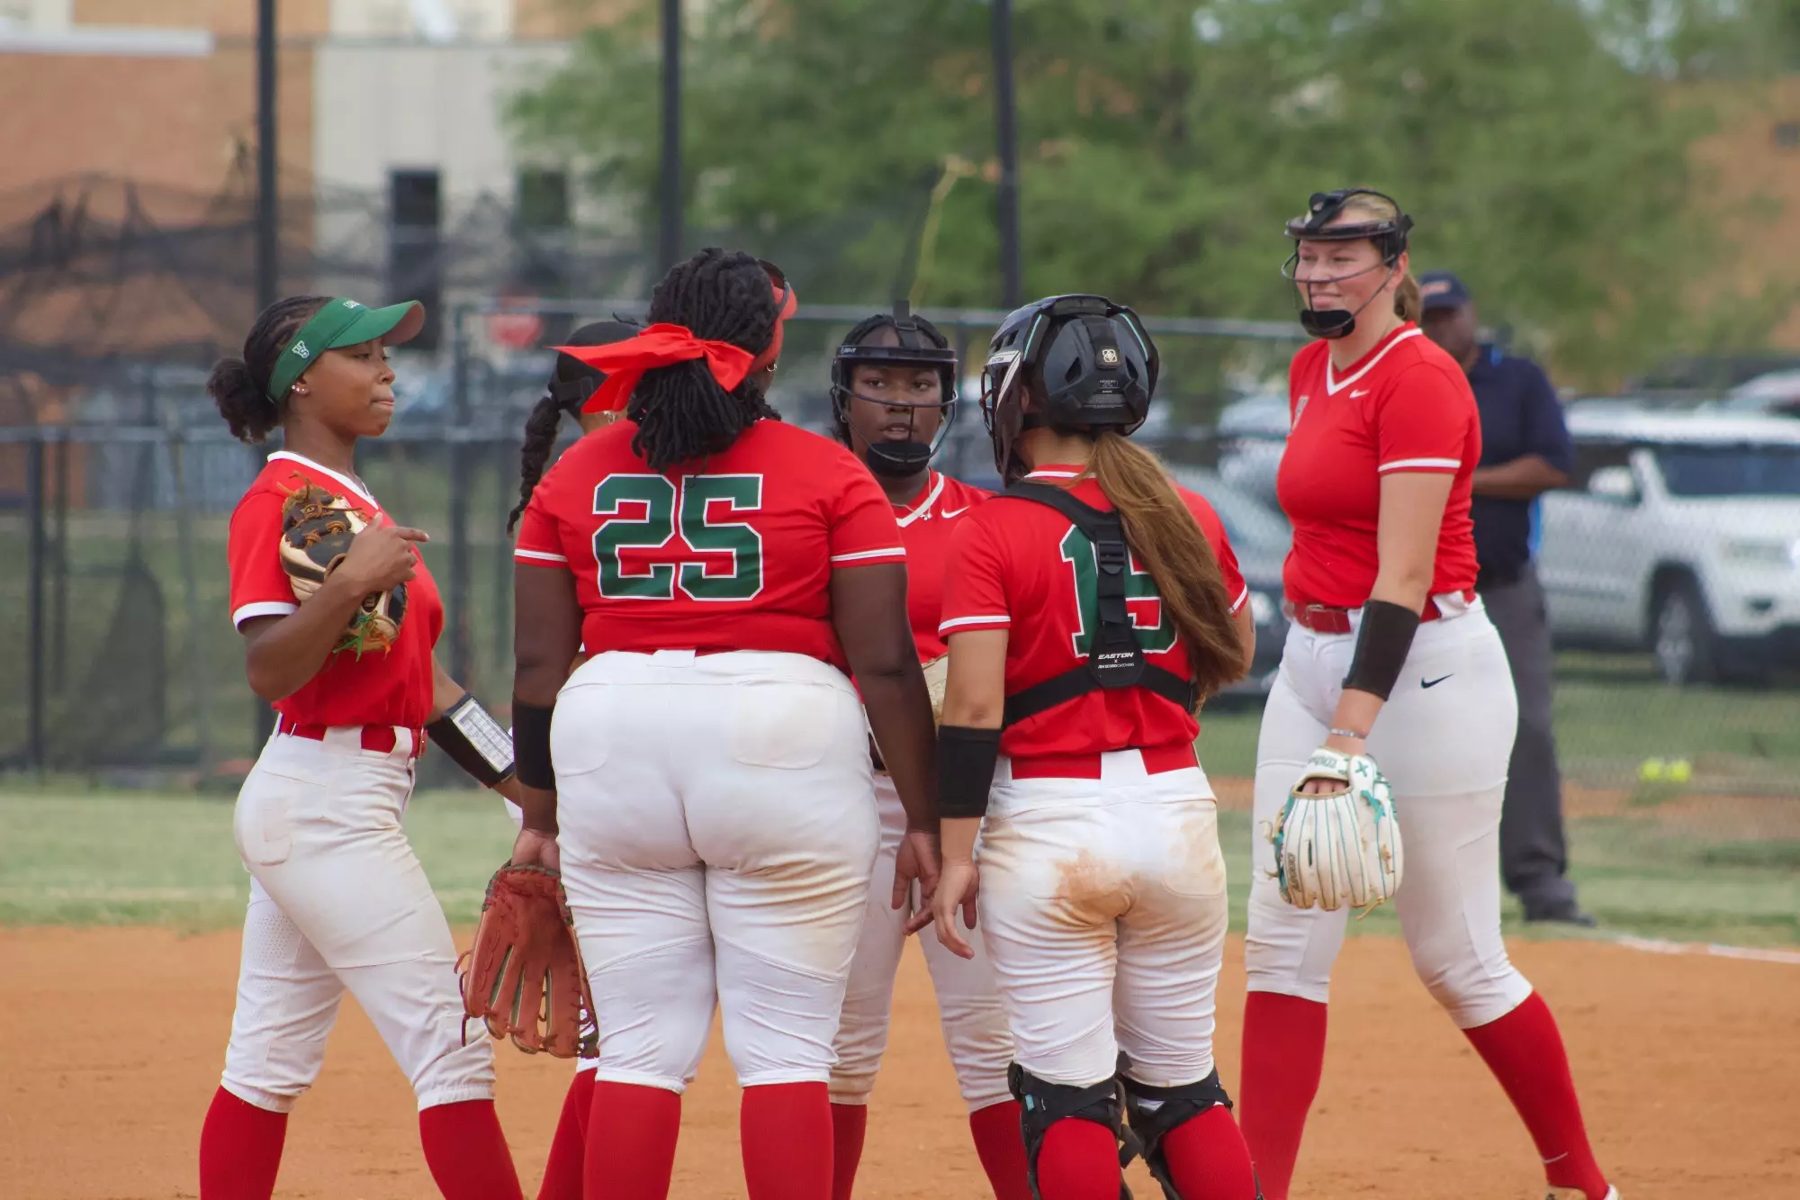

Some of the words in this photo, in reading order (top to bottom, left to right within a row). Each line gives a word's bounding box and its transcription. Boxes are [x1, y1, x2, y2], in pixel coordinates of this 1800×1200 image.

[592, 473, 763, 601] 25
[1059, 523, 1178, 658] 15
[1098, 652, 1134, 660] EASTON
